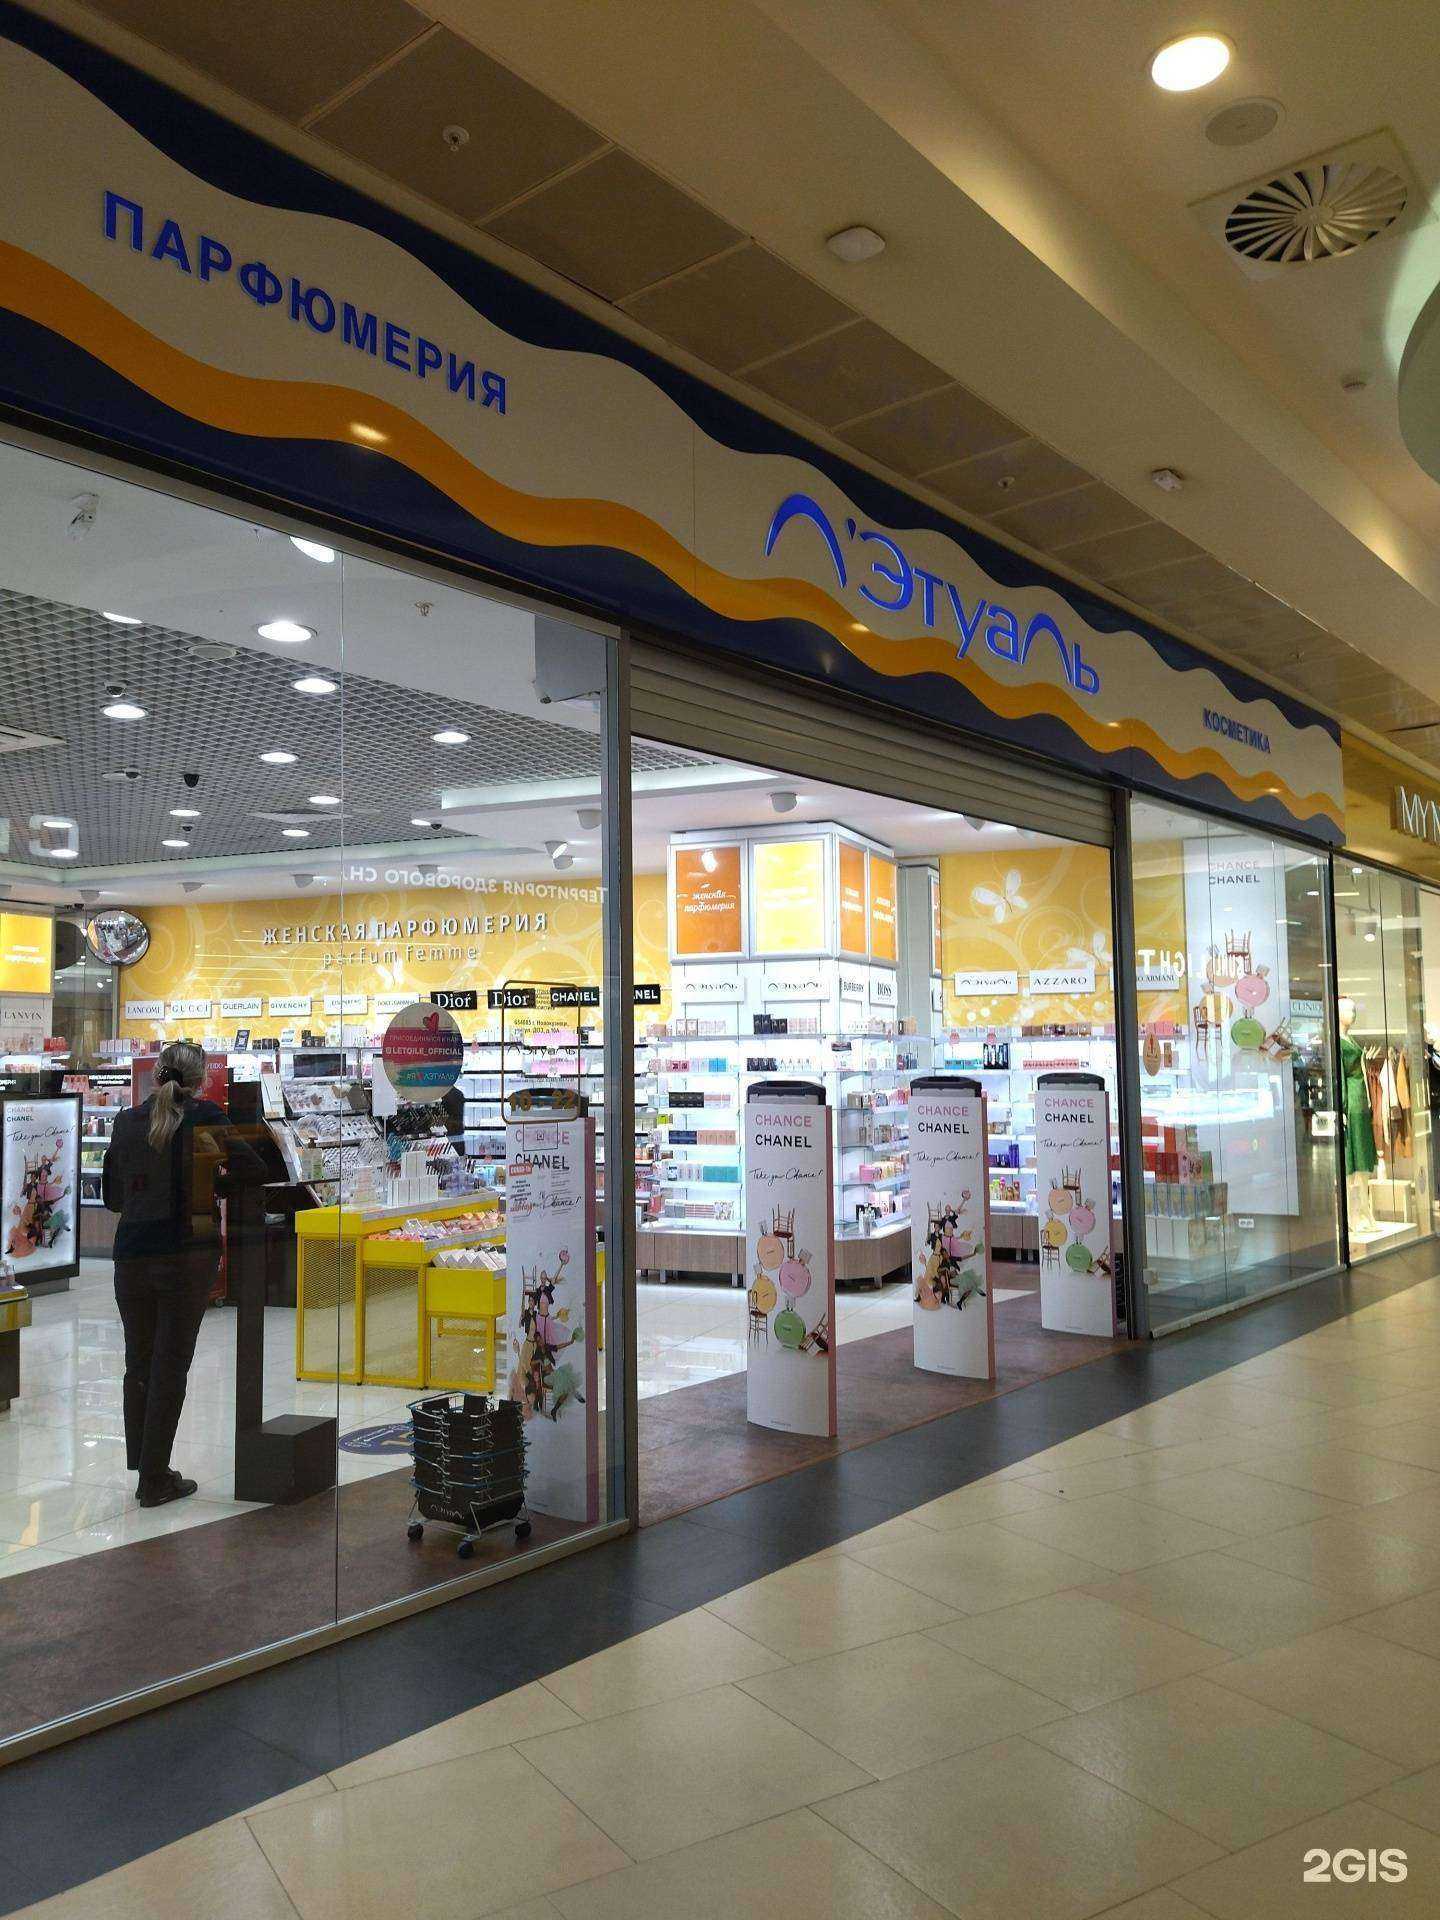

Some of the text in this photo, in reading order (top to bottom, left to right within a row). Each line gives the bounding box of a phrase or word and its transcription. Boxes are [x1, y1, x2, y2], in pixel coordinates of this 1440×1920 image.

[104, 190, 508, 415] ПАРФЮМЕРИЯ
[1202, 707, 1271, 755] КОСМЕТИКА
[1209, 875, 1261, 885] CHANEL
[263, 912, 548, 946] ЖЕНСКАЯ ПАРФЮМЕРИЯ
[405, 945, 480, 962] femme
[1033, 977, 1088, 987] AZZARO
[435, 992, 472, 1009] Dior
[492, 991, 530, 1007] Dior
[551, 992, 598, 1002] CHANEL
[171, 1004, 209, 1015] GUCCI
[222, 1002, 260, 1011] GUERLAIN
[270, 1002, 308, 1010] GIVENCHY
[4, 1010, 43, 1021] LANVIN
[1045, 1113, 1095, 1124] CHANEL
[917, 1122, 970, 1135] CHANEL
[755, 1134, 812, 1148] CHANEL
[515, 1153, 570, 1170] CHANEL
